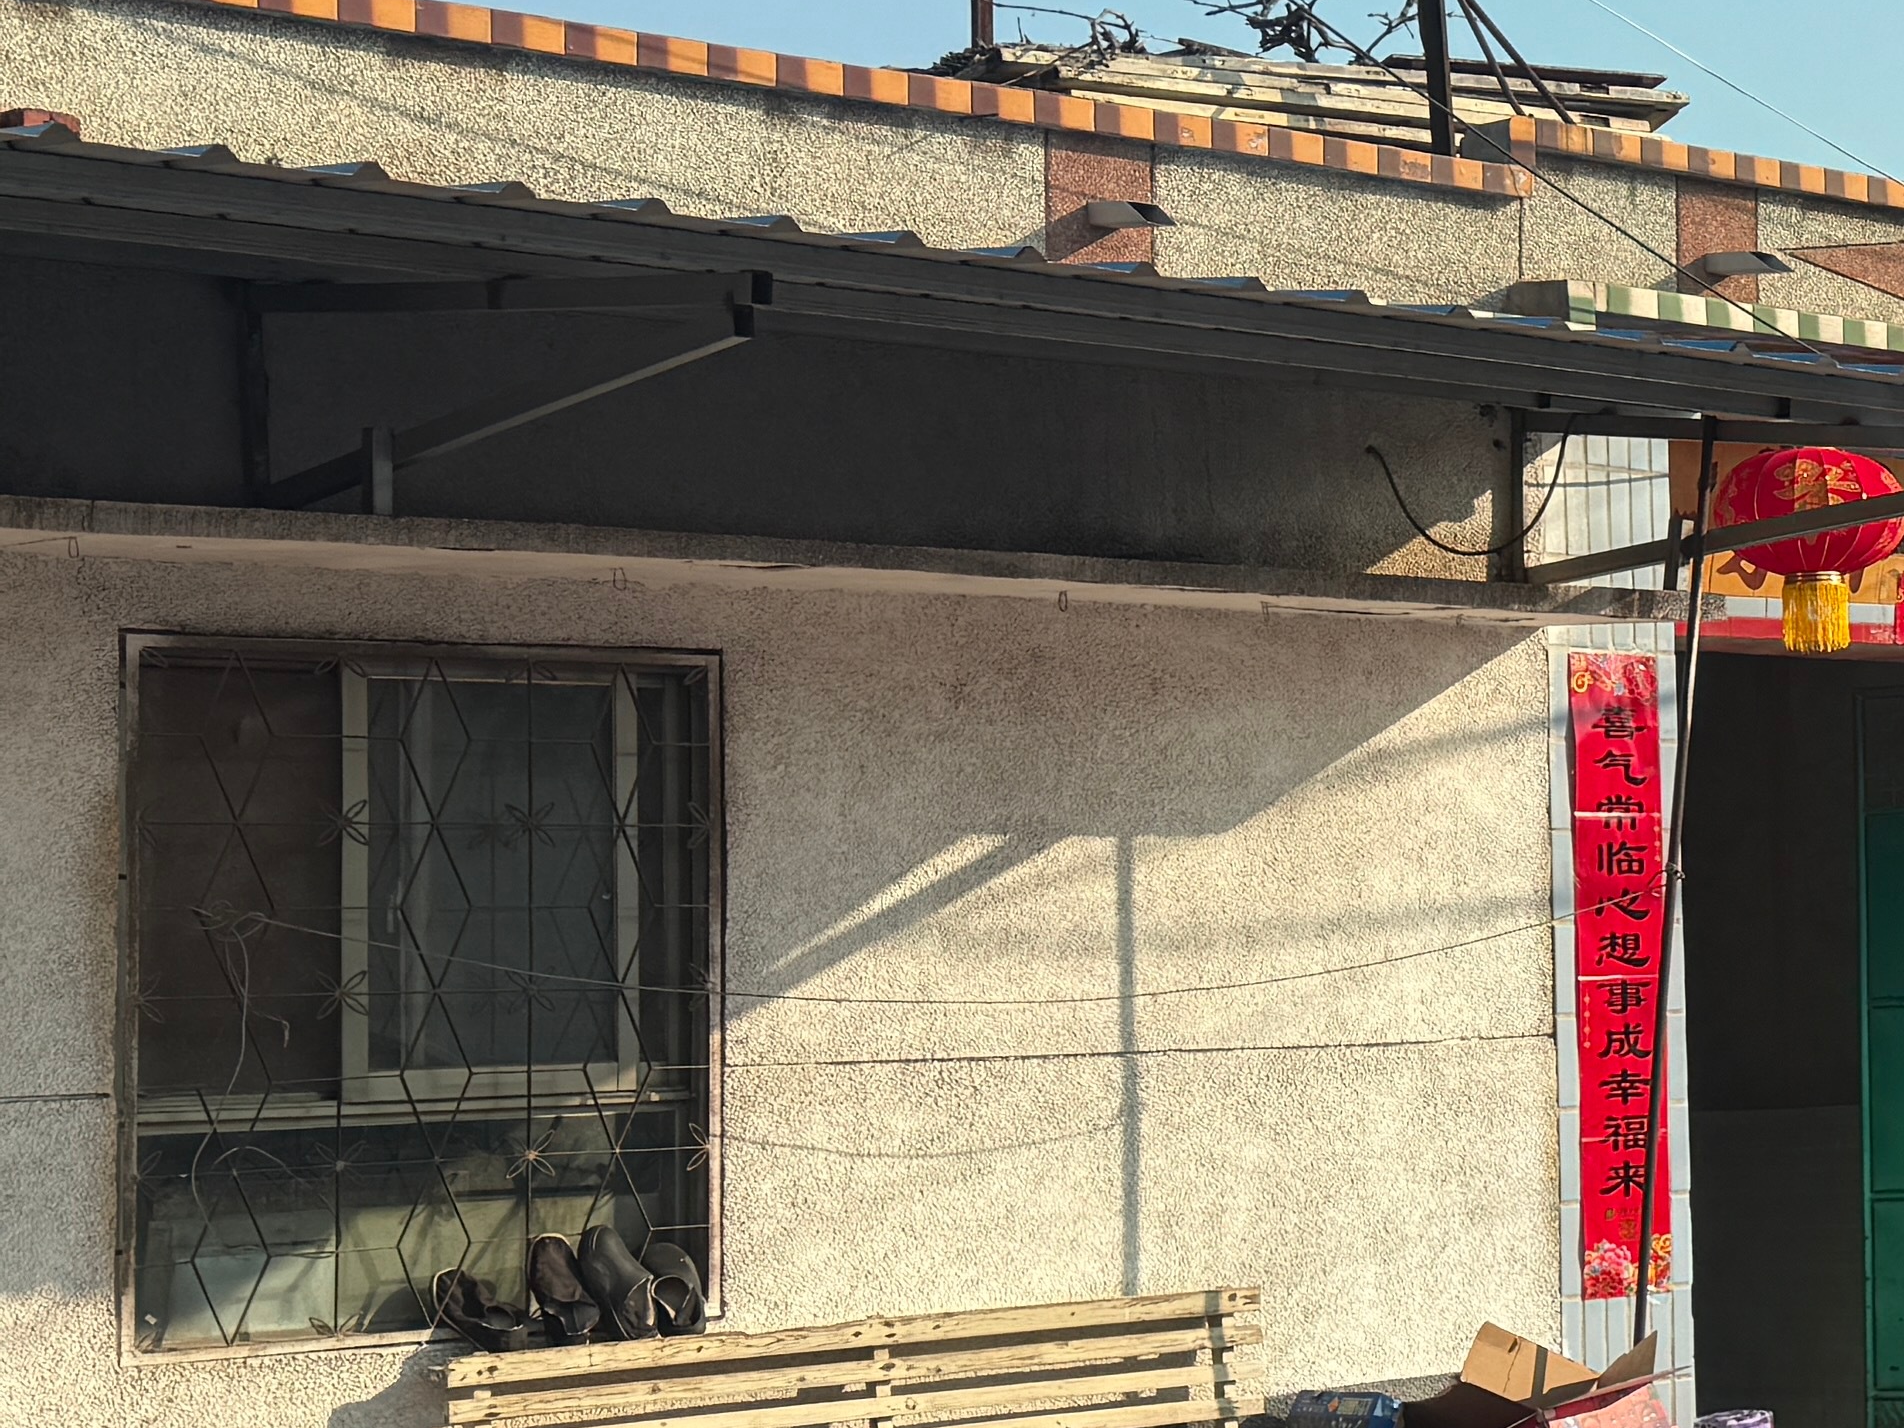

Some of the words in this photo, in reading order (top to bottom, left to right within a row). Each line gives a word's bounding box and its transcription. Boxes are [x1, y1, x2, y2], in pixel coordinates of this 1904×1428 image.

[1590, 705, 1652, 1198] 喜气常临心想事成幸福来
